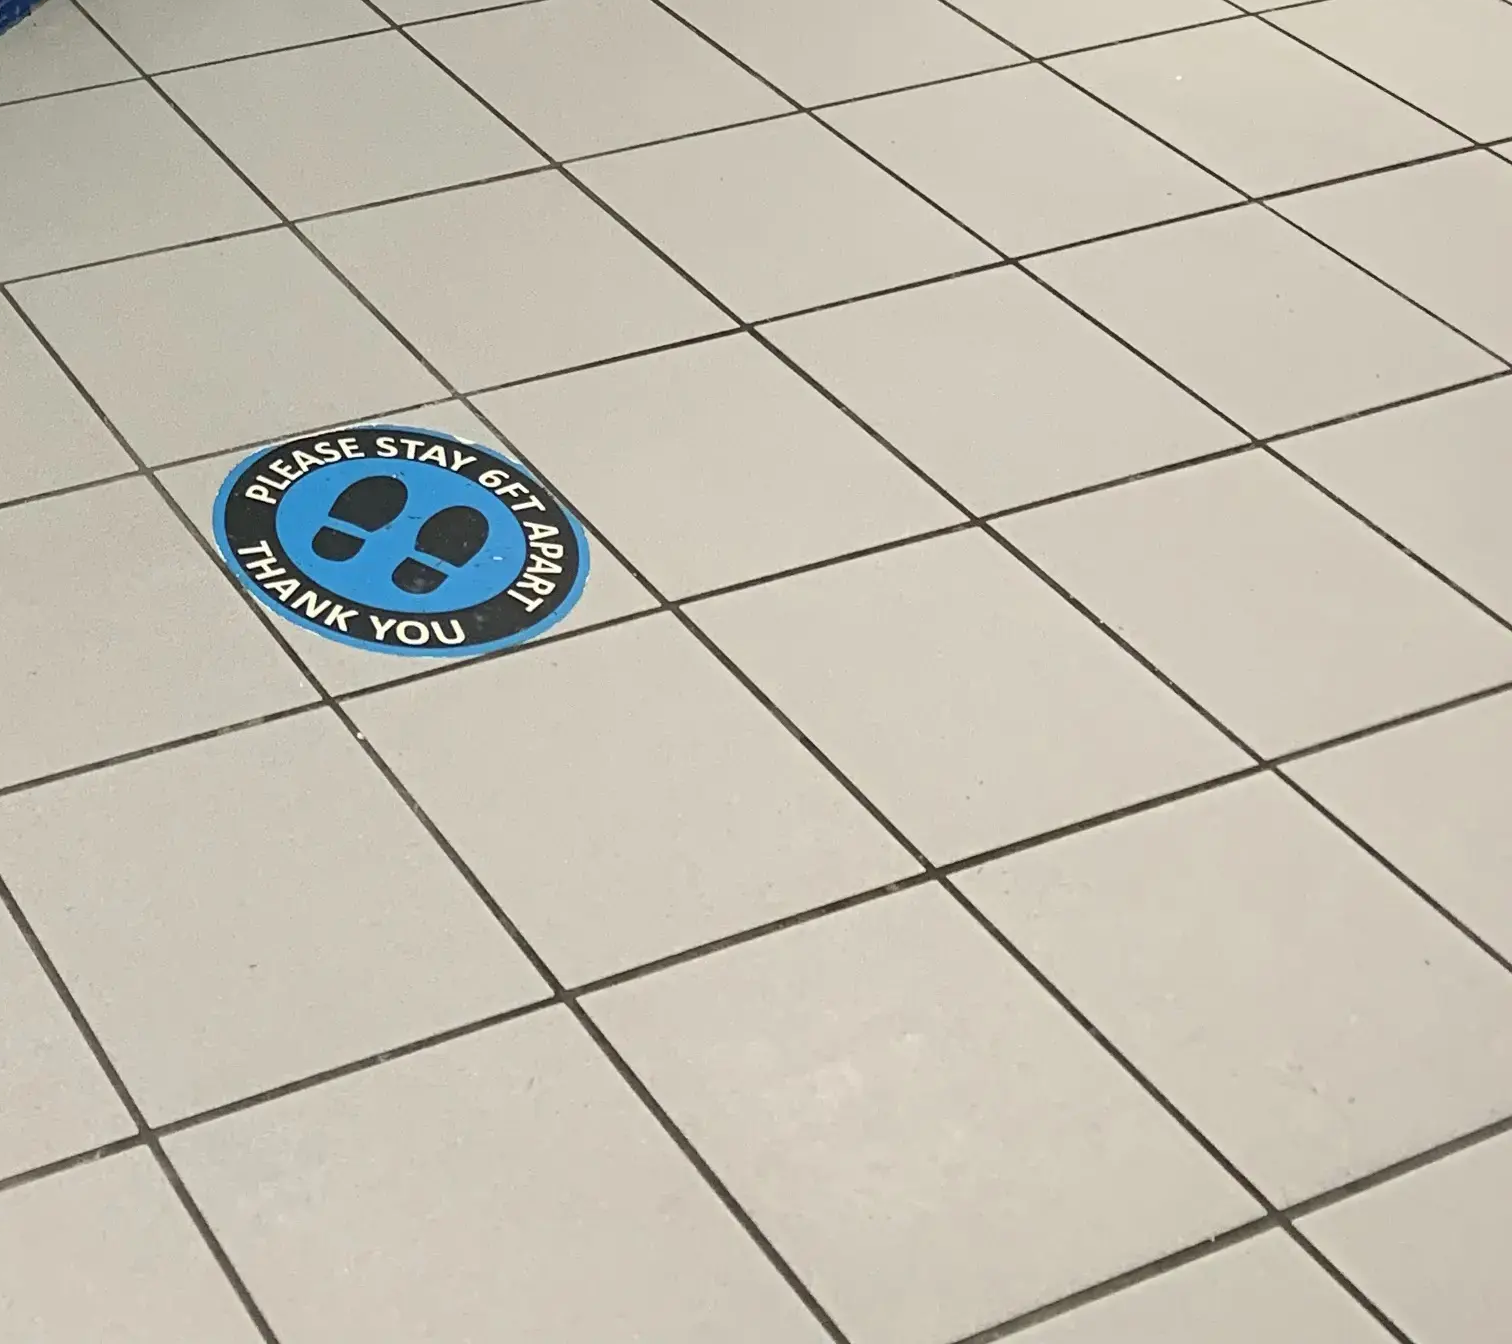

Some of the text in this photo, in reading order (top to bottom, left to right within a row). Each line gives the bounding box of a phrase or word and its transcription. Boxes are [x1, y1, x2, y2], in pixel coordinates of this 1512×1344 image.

[237, 540, 466, 646] THANK YOU
[245, 436, 565, 613] PLEASE STAY 6FT APART
